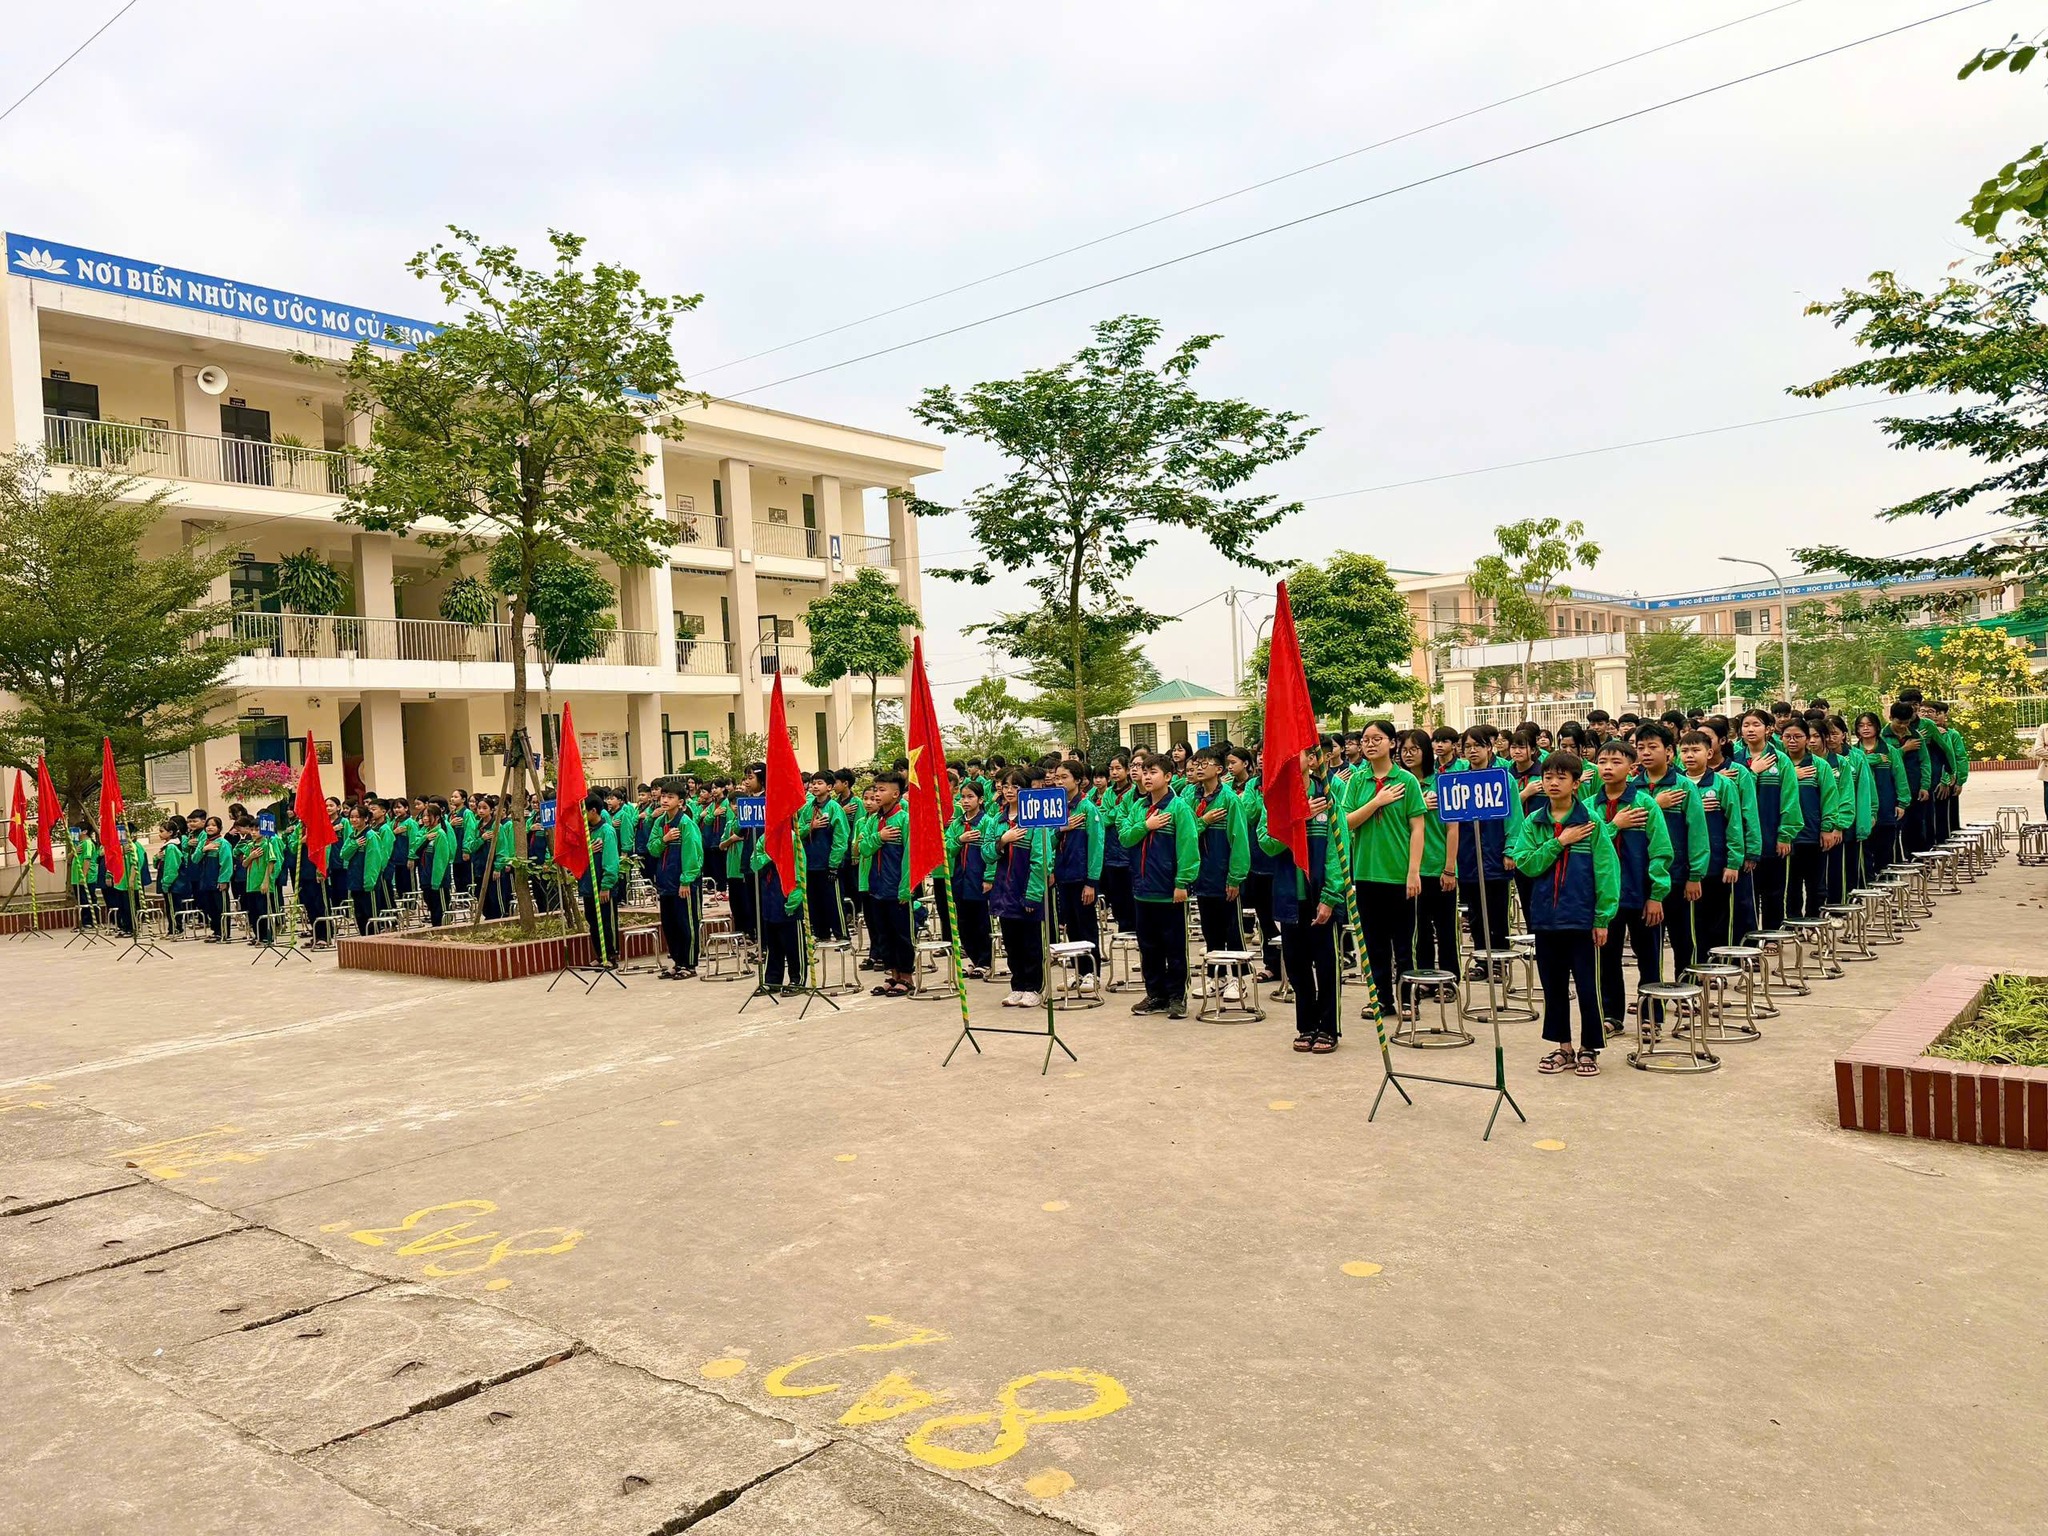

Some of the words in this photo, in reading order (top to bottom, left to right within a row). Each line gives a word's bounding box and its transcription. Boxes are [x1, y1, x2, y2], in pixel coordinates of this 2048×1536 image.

[76, 258, 122, 287] NƠI
[126, 266, 182, 299] BIẾN
[187, 281, 268, 316] NHỮNG
[273, 297, 317, 326] ƯỚC
[321, 309, 350, 332] MƠ
[832, 538, 840, 557] A
[1443, 778, 1470, 811] LỚP
[1474, 781, 1504, 809] 8A2
[541, 804, 551, 822] LỚP
[739, 800, 752, 821] LỚP
[1021, 794, 1040, 820] LỚP
[1043, 797, 1063, 819] 8A3
